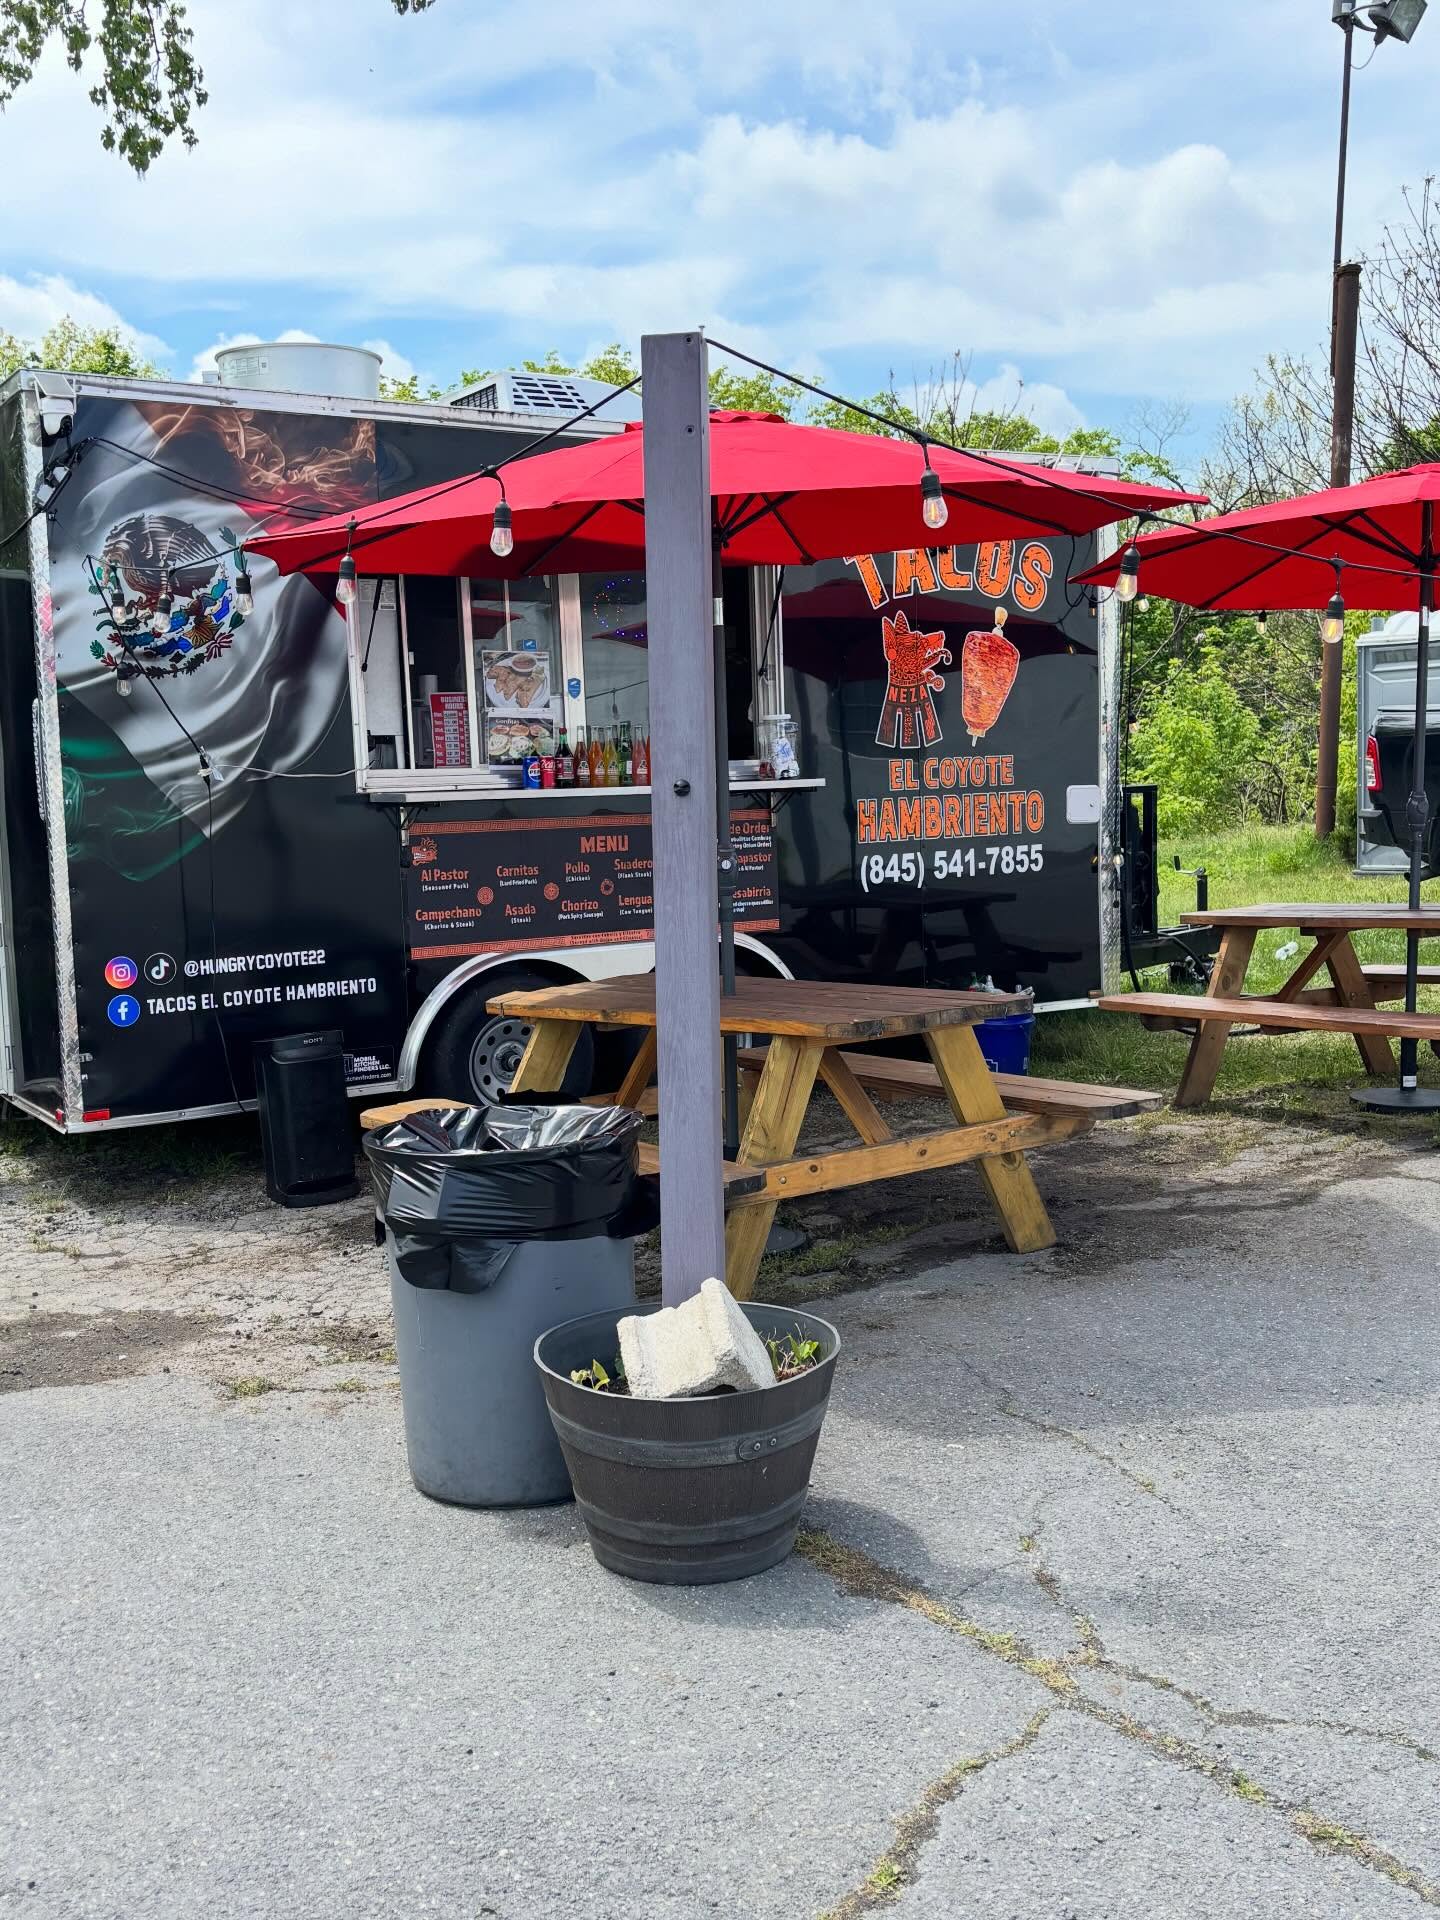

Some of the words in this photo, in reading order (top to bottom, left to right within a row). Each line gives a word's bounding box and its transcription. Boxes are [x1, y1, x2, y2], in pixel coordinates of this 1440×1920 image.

[843, 539, 1053, 612] TACOS
[888, 685, 928, 703] NEZA
[889, 758, 919, 791] EL
[924, 754, 1015, 789] COYOTE
[857, 790, 1045, 844] HAMBRIENTO
[742, 822, 770, 834] Order
[580, 835, 629, 854] MENU
[496, 864, 539, 877] Carnitas
[565, 861, 590, 874] Pollo
[614, 858, 653, 871] Suadero
[860, 851, 925, 893] (845)
[933, 843, 1044, 880] 541-7855
[421, 870, 431, 881] Al
[434, 868, 469, 881] Pastor
[422, 884, 452, 892] (Seasoned
[561, 899, 599, 912] Chorizo
[618, 895, 652, 908] Lengua
[415, 906, 482, 922] Campechano
[505, 904, 536, 916] Asada
[424, 923, 449, 931] (Chorizo
[455, 920, 474, 928] Steak)
[184, 950, 326, 977] @HUNGRYCOYOTE22
[146, 995, 196, 1014] TACOS
[223, 986, 282, 1007] COYOTE
[286, 978, 377, 1001] HAMBRIENTO
